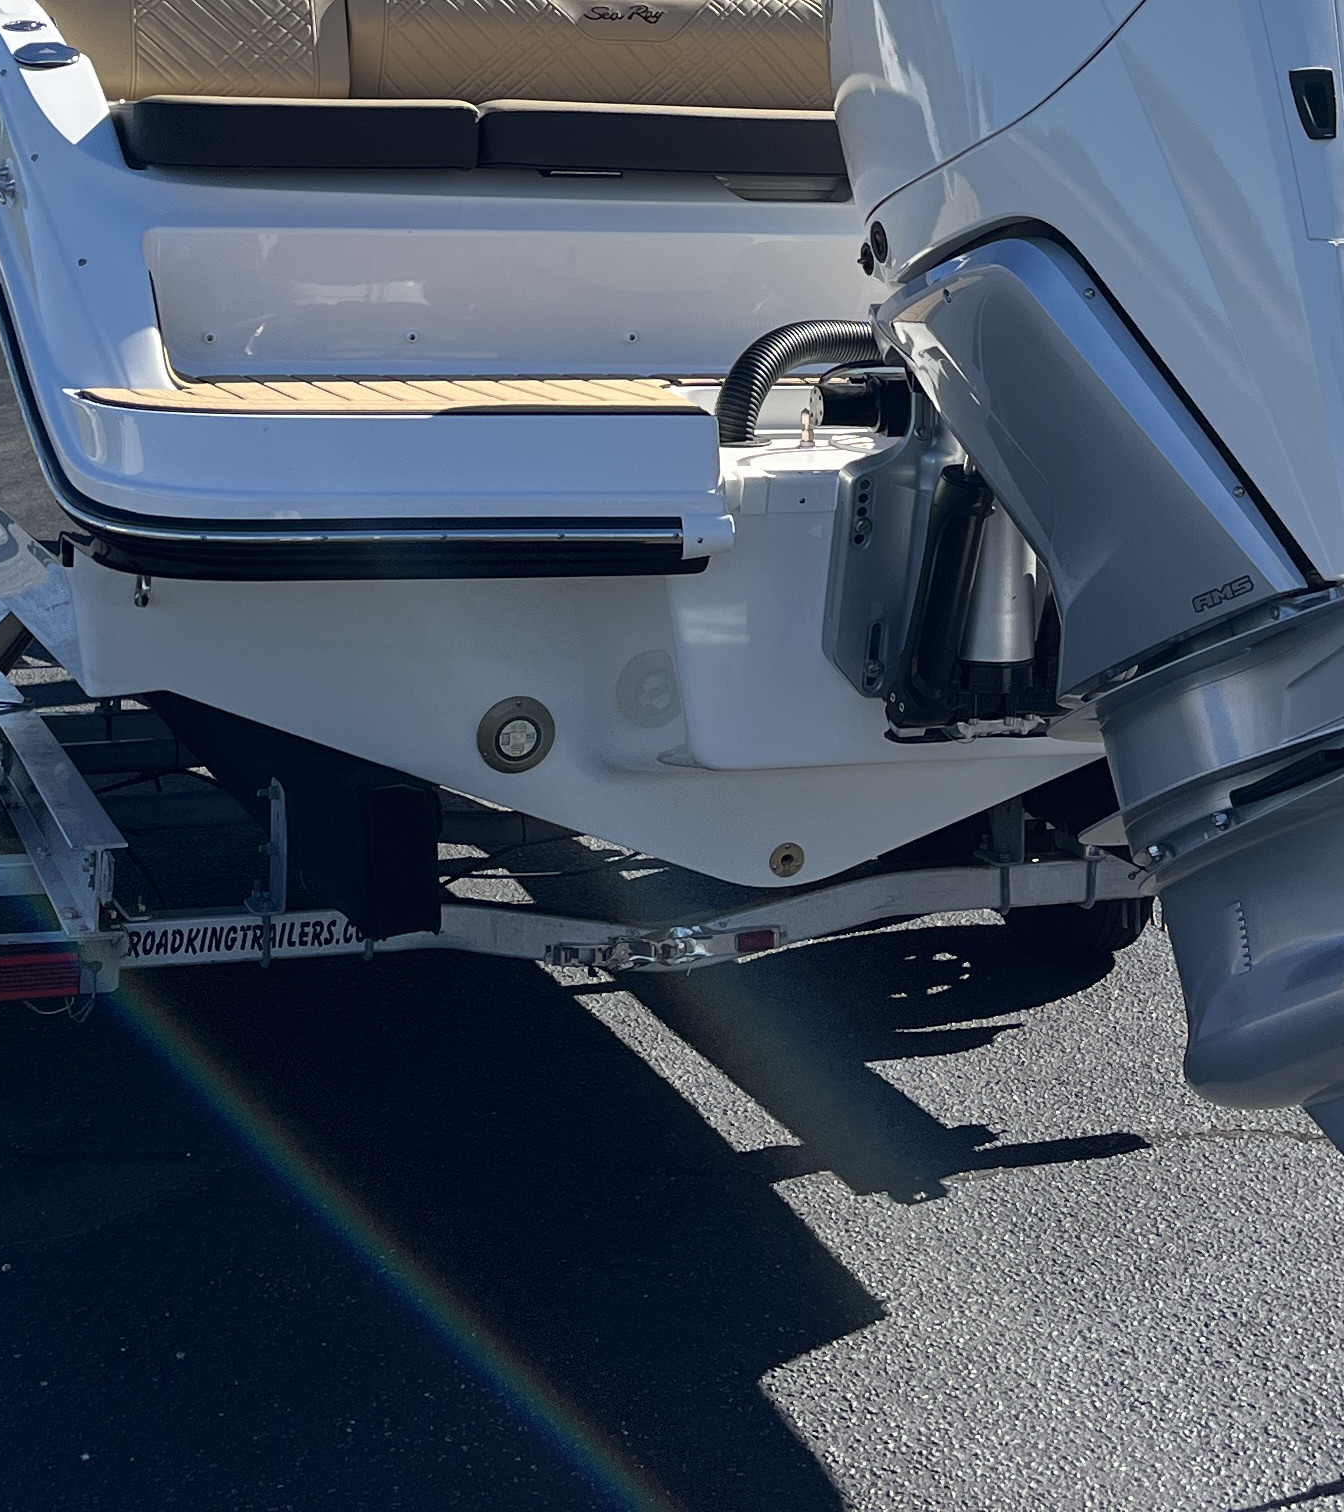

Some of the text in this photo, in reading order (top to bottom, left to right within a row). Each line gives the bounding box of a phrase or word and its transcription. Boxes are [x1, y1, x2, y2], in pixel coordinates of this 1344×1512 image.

[583, 4, 666, 24] Sea Ray
[1192, 574, 1254, 613] AMS
[128, 919, 386, 959] ROADKINGTRAILERS.CO
